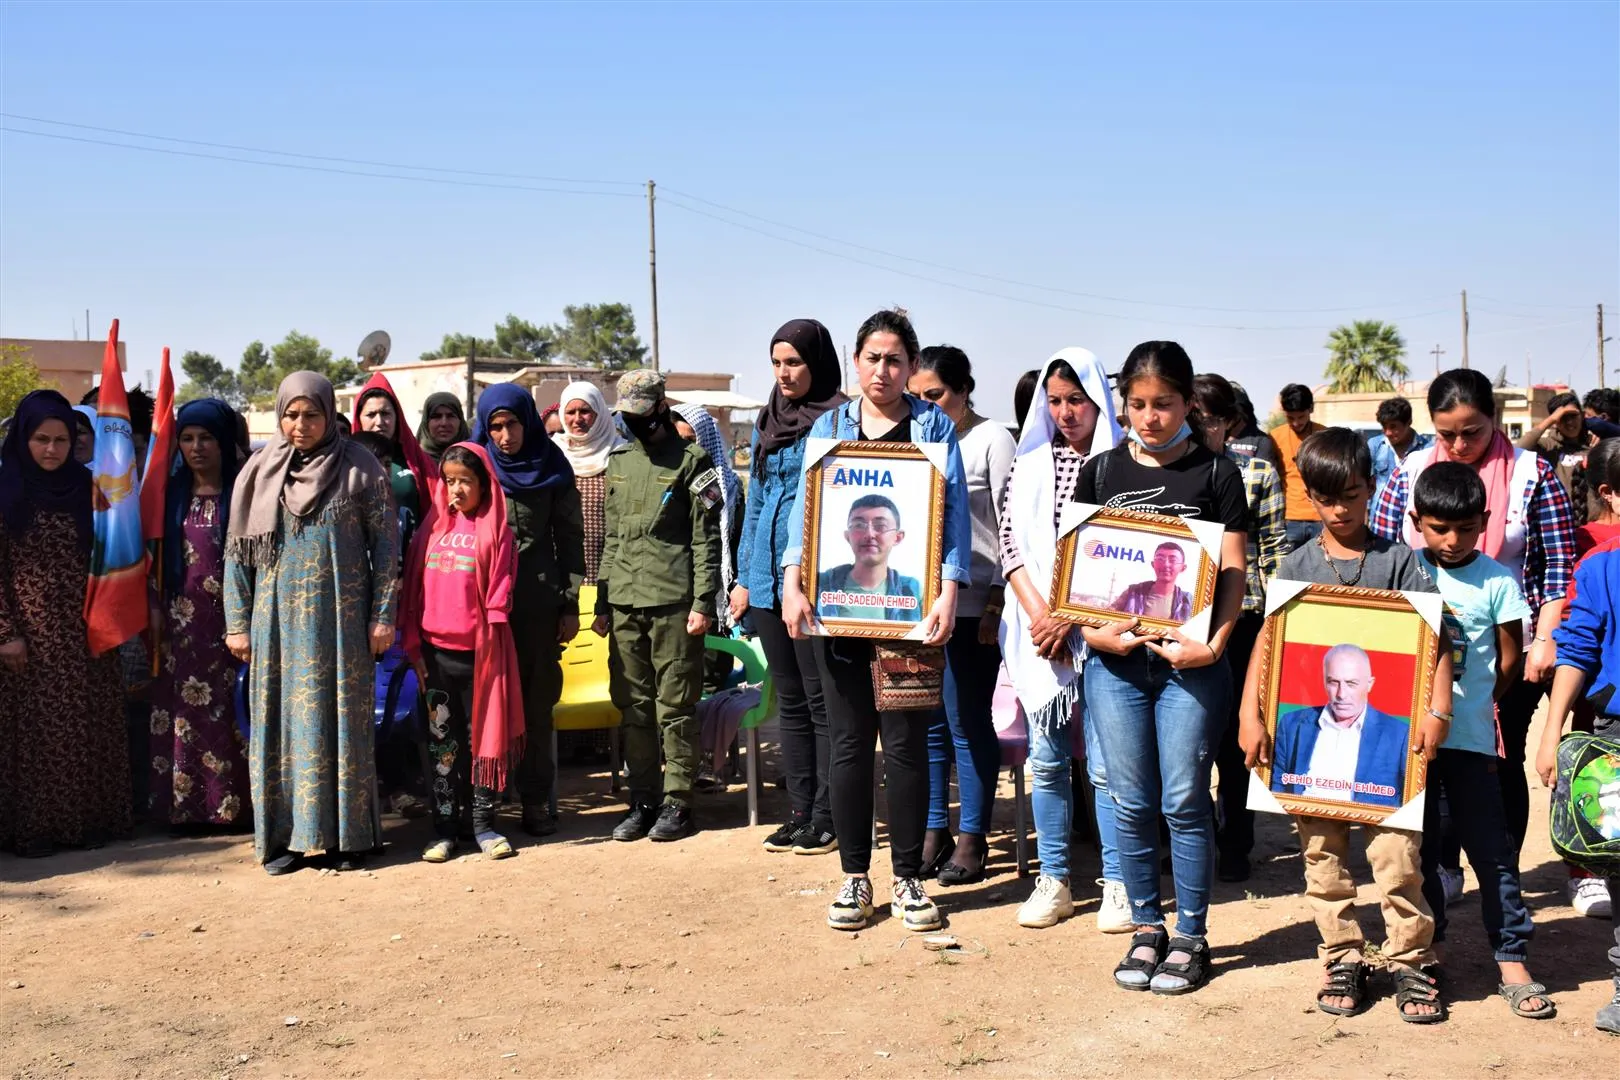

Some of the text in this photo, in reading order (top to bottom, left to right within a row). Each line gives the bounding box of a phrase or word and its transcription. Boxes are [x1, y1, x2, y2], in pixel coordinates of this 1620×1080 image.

[832, 467, 894, 488] ANHA
[440, 532, 478, 550] UCCI
[1092, 543, 1146, 563] ANHA
[821, 590, 917, 609] ŞEHİD SADEDİN EHMED
[1281, 773, 1396, 796] ŞEHİD EZEDİN EHİMED
